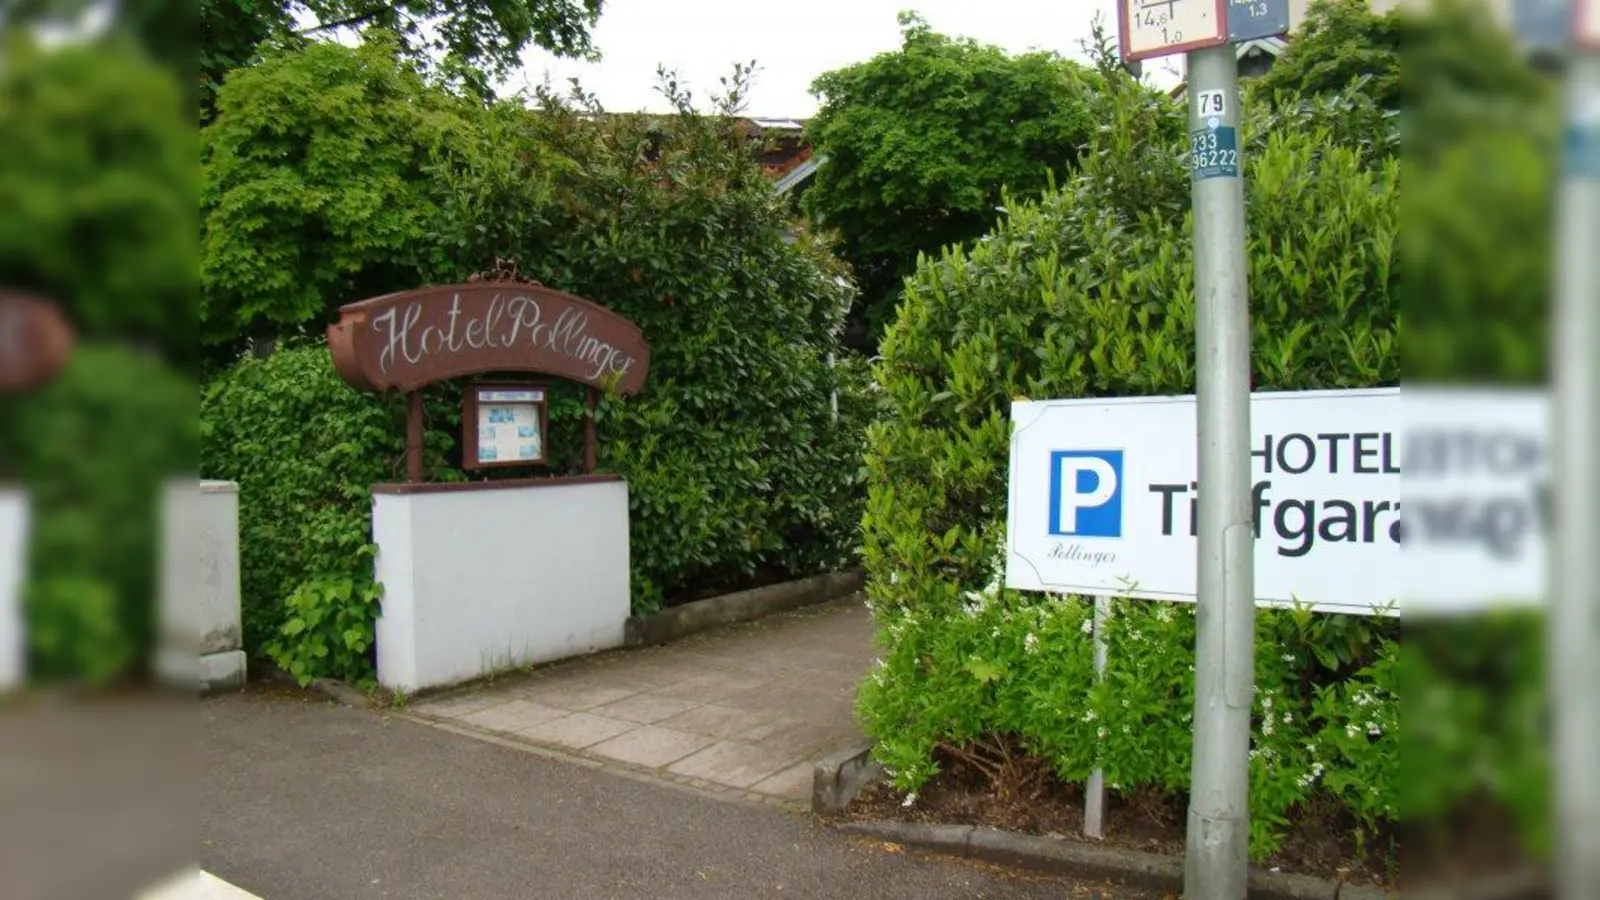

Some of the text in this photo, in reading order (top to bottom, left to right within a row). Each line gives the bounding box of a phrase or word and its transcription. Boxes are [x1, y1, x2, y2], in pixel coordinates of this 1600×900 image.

[1200, 94, 1223, 113] 79
[1192, 134, 1217, 153] 233
[1192, 149, 1236, 170] 96222
[373, 293, 636, 380] Hotel Pollinger
[1060, 456, 1117, 532] P
[1047, 541, 1116, 568] Pollinger
